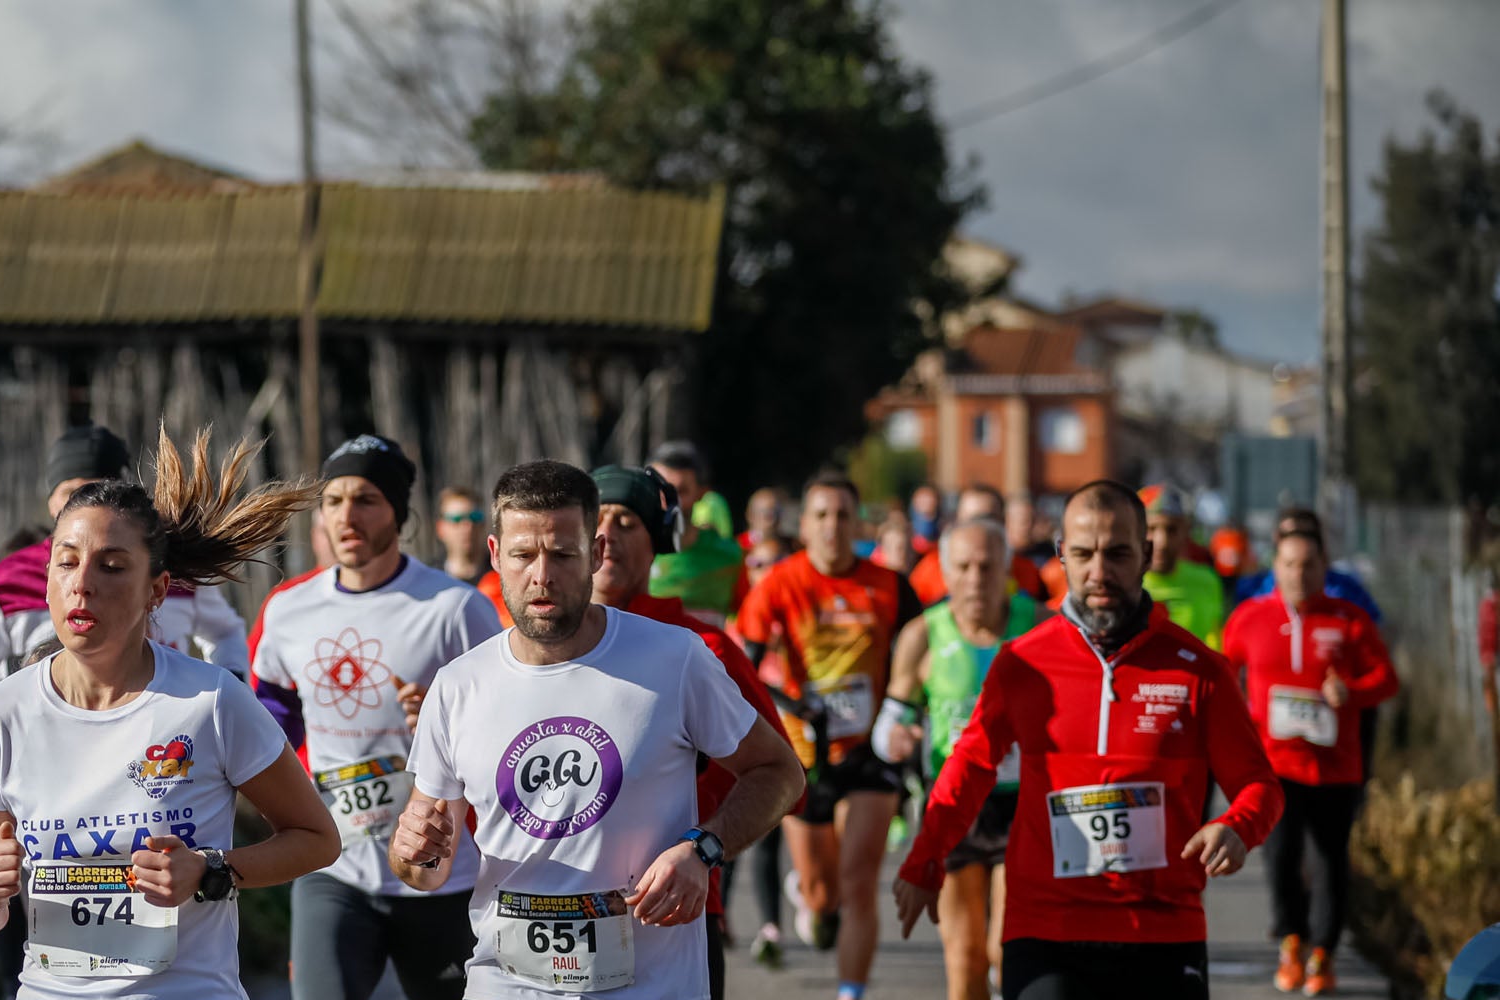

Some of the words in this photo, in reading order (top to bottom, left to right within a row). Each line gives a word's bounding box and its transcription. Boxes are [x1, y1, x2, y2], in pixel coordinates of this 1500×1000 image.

[506, 722, 557, 768] apuesta
[562, 722, 572, 733] x
[575, 722, 610, 751] abril
[340, 780, 393, 815] 382
[21, 819, 65, 831] CLUB
[76, 807, 193, 829] ATLETISMO
[1090, 811, 1131, 841] 95
[35, 868, 46, 879] 26
[56, 867, 67, 883] VII
[67, 867, 123, 876] CARRERA
[65, 883, 98, 891] Secaderos
[71, 896, 134, 926] 674
[502, 894, 513, 904] 26
[530, 897, 579, 905] CARRERA
[527, 921, 597, 953] 651
[100, 957, 128, 965] olimpo
[553, 957, 581, 970] RAUL
